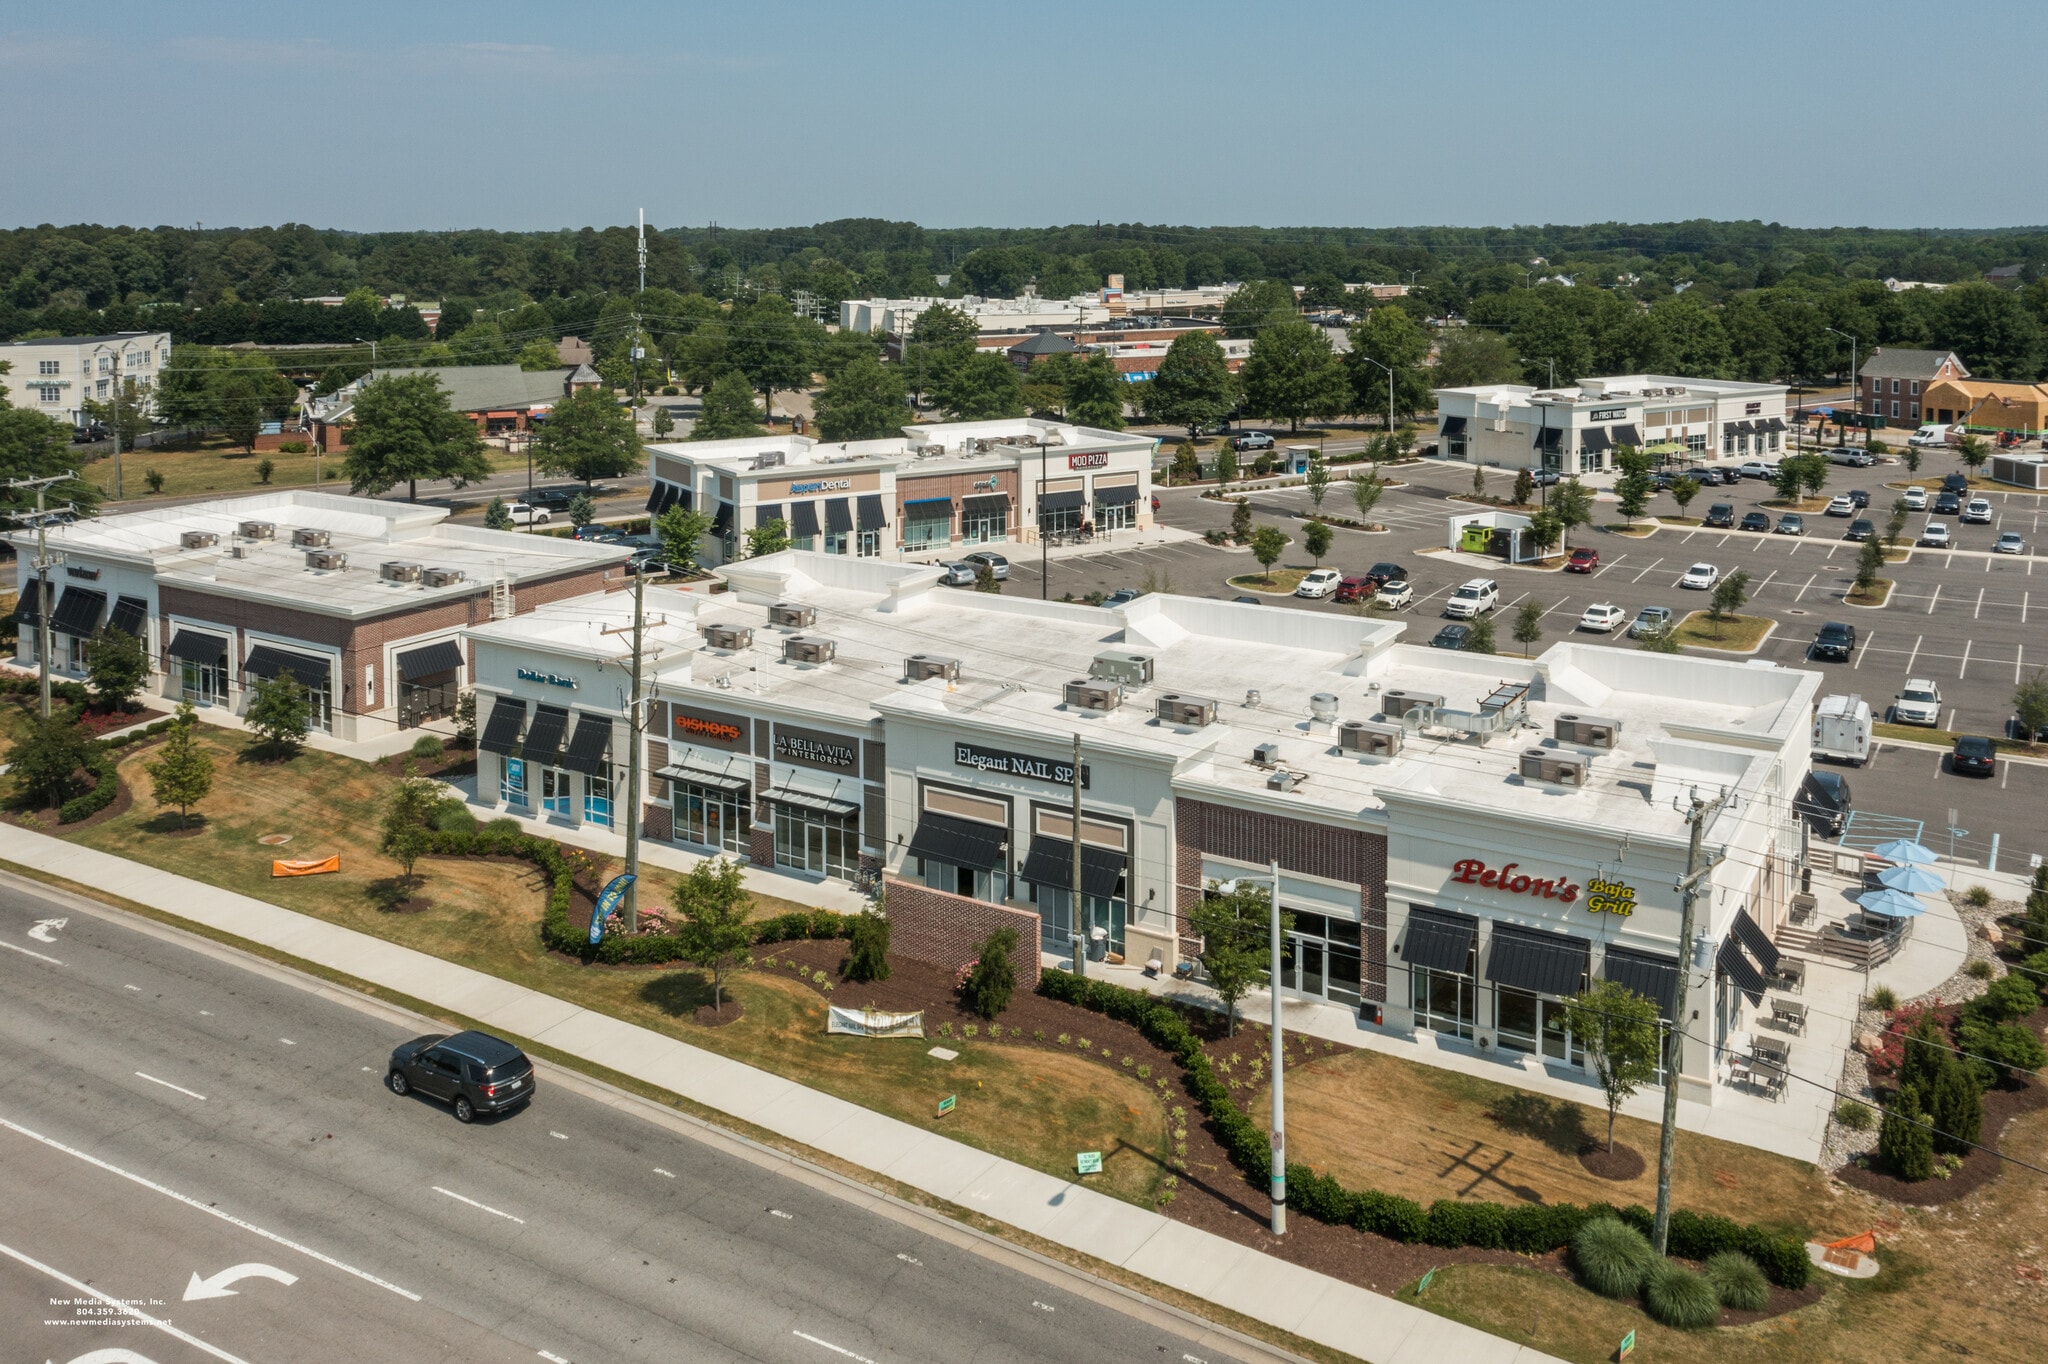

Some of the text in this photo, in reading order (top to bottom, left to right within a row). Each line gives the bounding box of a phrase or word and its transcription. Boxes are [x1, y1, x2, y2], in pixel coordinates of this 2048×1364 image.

[1071, 453, 1108, 467] MOD PIZZA
[517, 667, 577, 689] Dollar Bank
[675, 715, 742, 739] BISHOPS
[773, 733, 853, 760] LA BELLA VITA
[788, 748, 838, 765] INTERIORS
[957, 747, 1009, 771] Elegant
[1011, 757, 1052, 779] NAIL
[1451, 858, 1637, 903] Pelon's Baja
[1587, 895, 1637, 917] Grill
[868, 1014, 892, 1028] NOW
